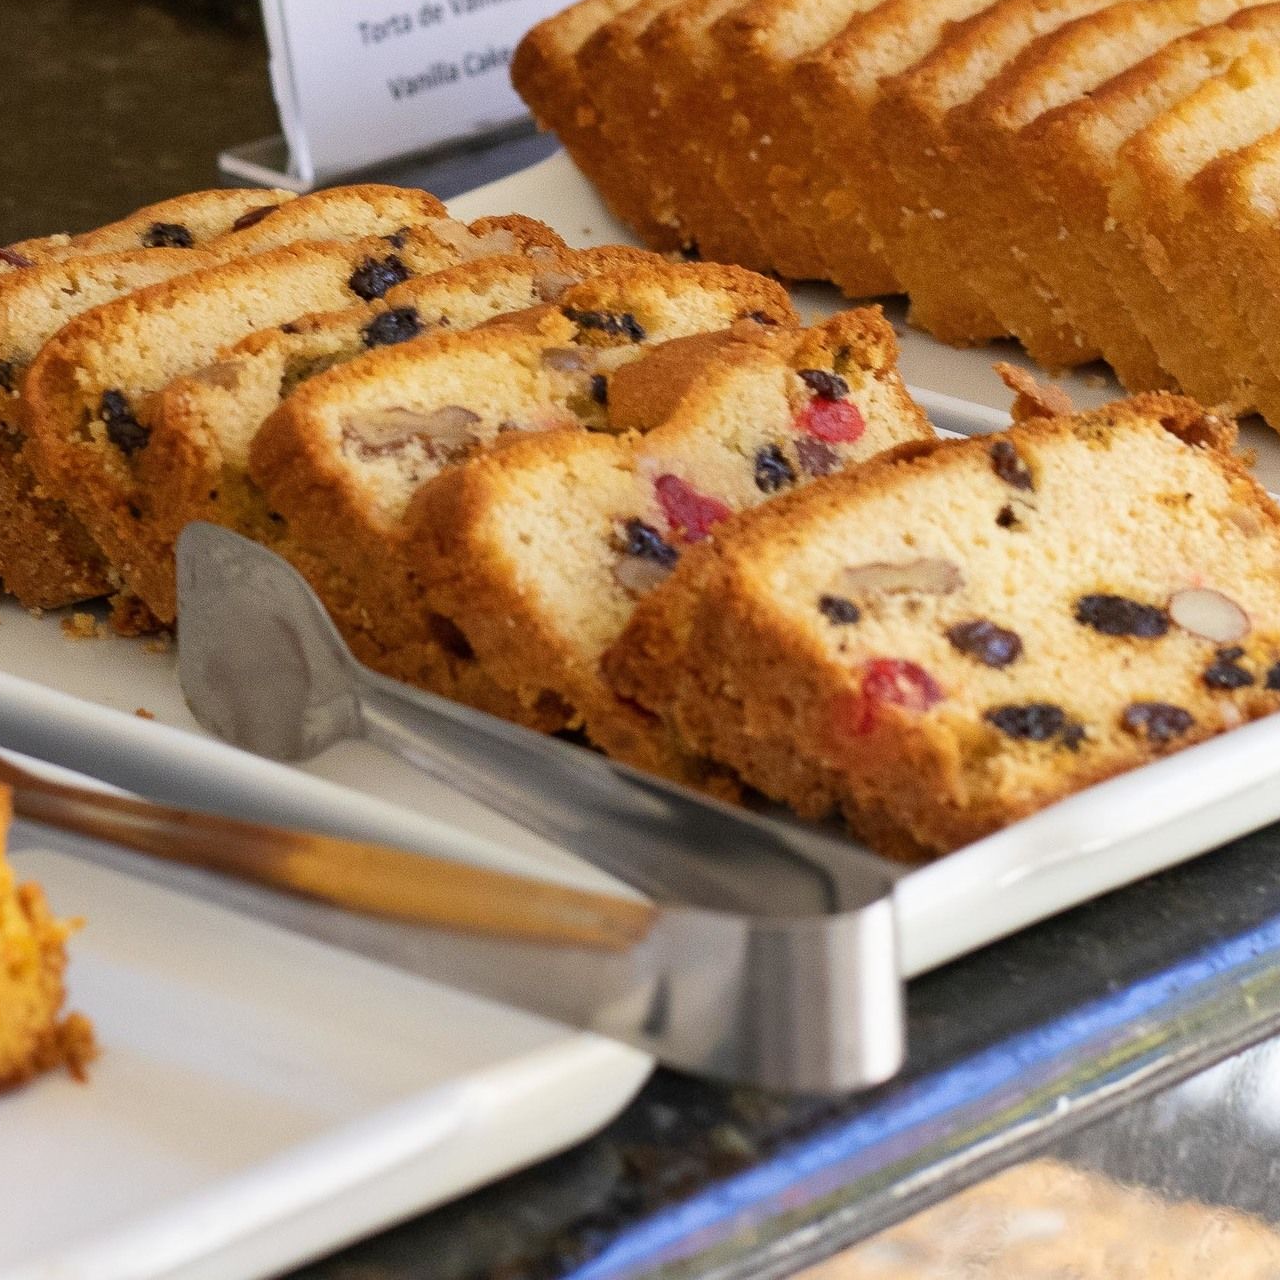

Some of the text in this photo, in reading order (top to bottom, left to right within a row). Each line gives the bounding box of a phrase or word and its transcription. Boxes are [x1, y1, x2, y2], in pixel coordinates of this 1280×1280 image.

[357, 14, 413, 46] Torta
[418, 0, 445, 28] de
[388, 61, 460, 101] Vanilla
